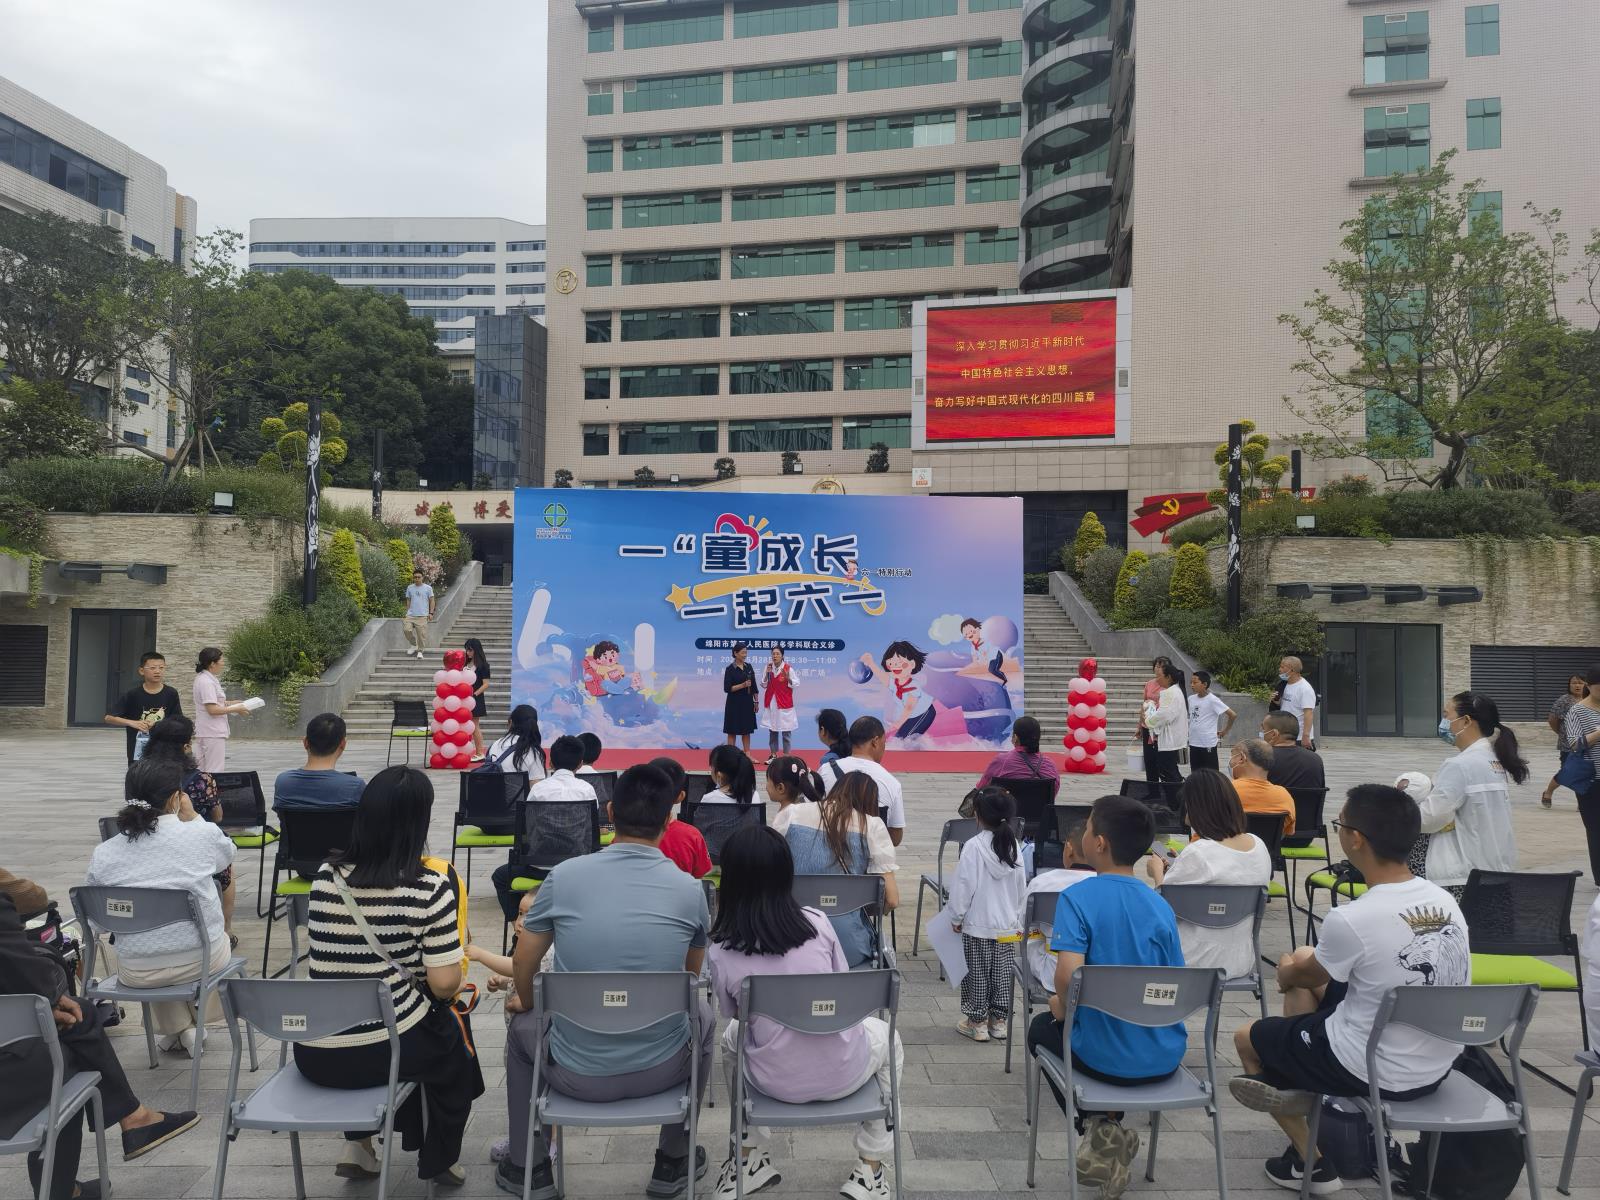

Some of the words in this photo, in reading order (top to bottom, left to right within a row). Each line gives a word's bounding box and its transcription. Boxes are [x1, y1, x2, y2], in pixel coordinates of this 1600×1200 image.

[955, 335, 1085, 352] 深入学习贯彻习近平新时代
[935, 391, 1096, 408] 奋力写好中国式现代化的四川篇章
[861, 568, 912, 577] 六一特别行动
[681, 581, 885, 629] 一起六一
[705, 639, 836, 650] 绵阳市第人民医院多学科联合义诊
[107, 902, 132, 913] 三医讲堂
[605, 994, 627, 1002] 三医讲堂
[1146, 987, 1176, 1000] 三医讲堂
[813, 1003, 834, 1012] 三医讲堂
[283, 1018, 306, 1027] 三医讲堂
